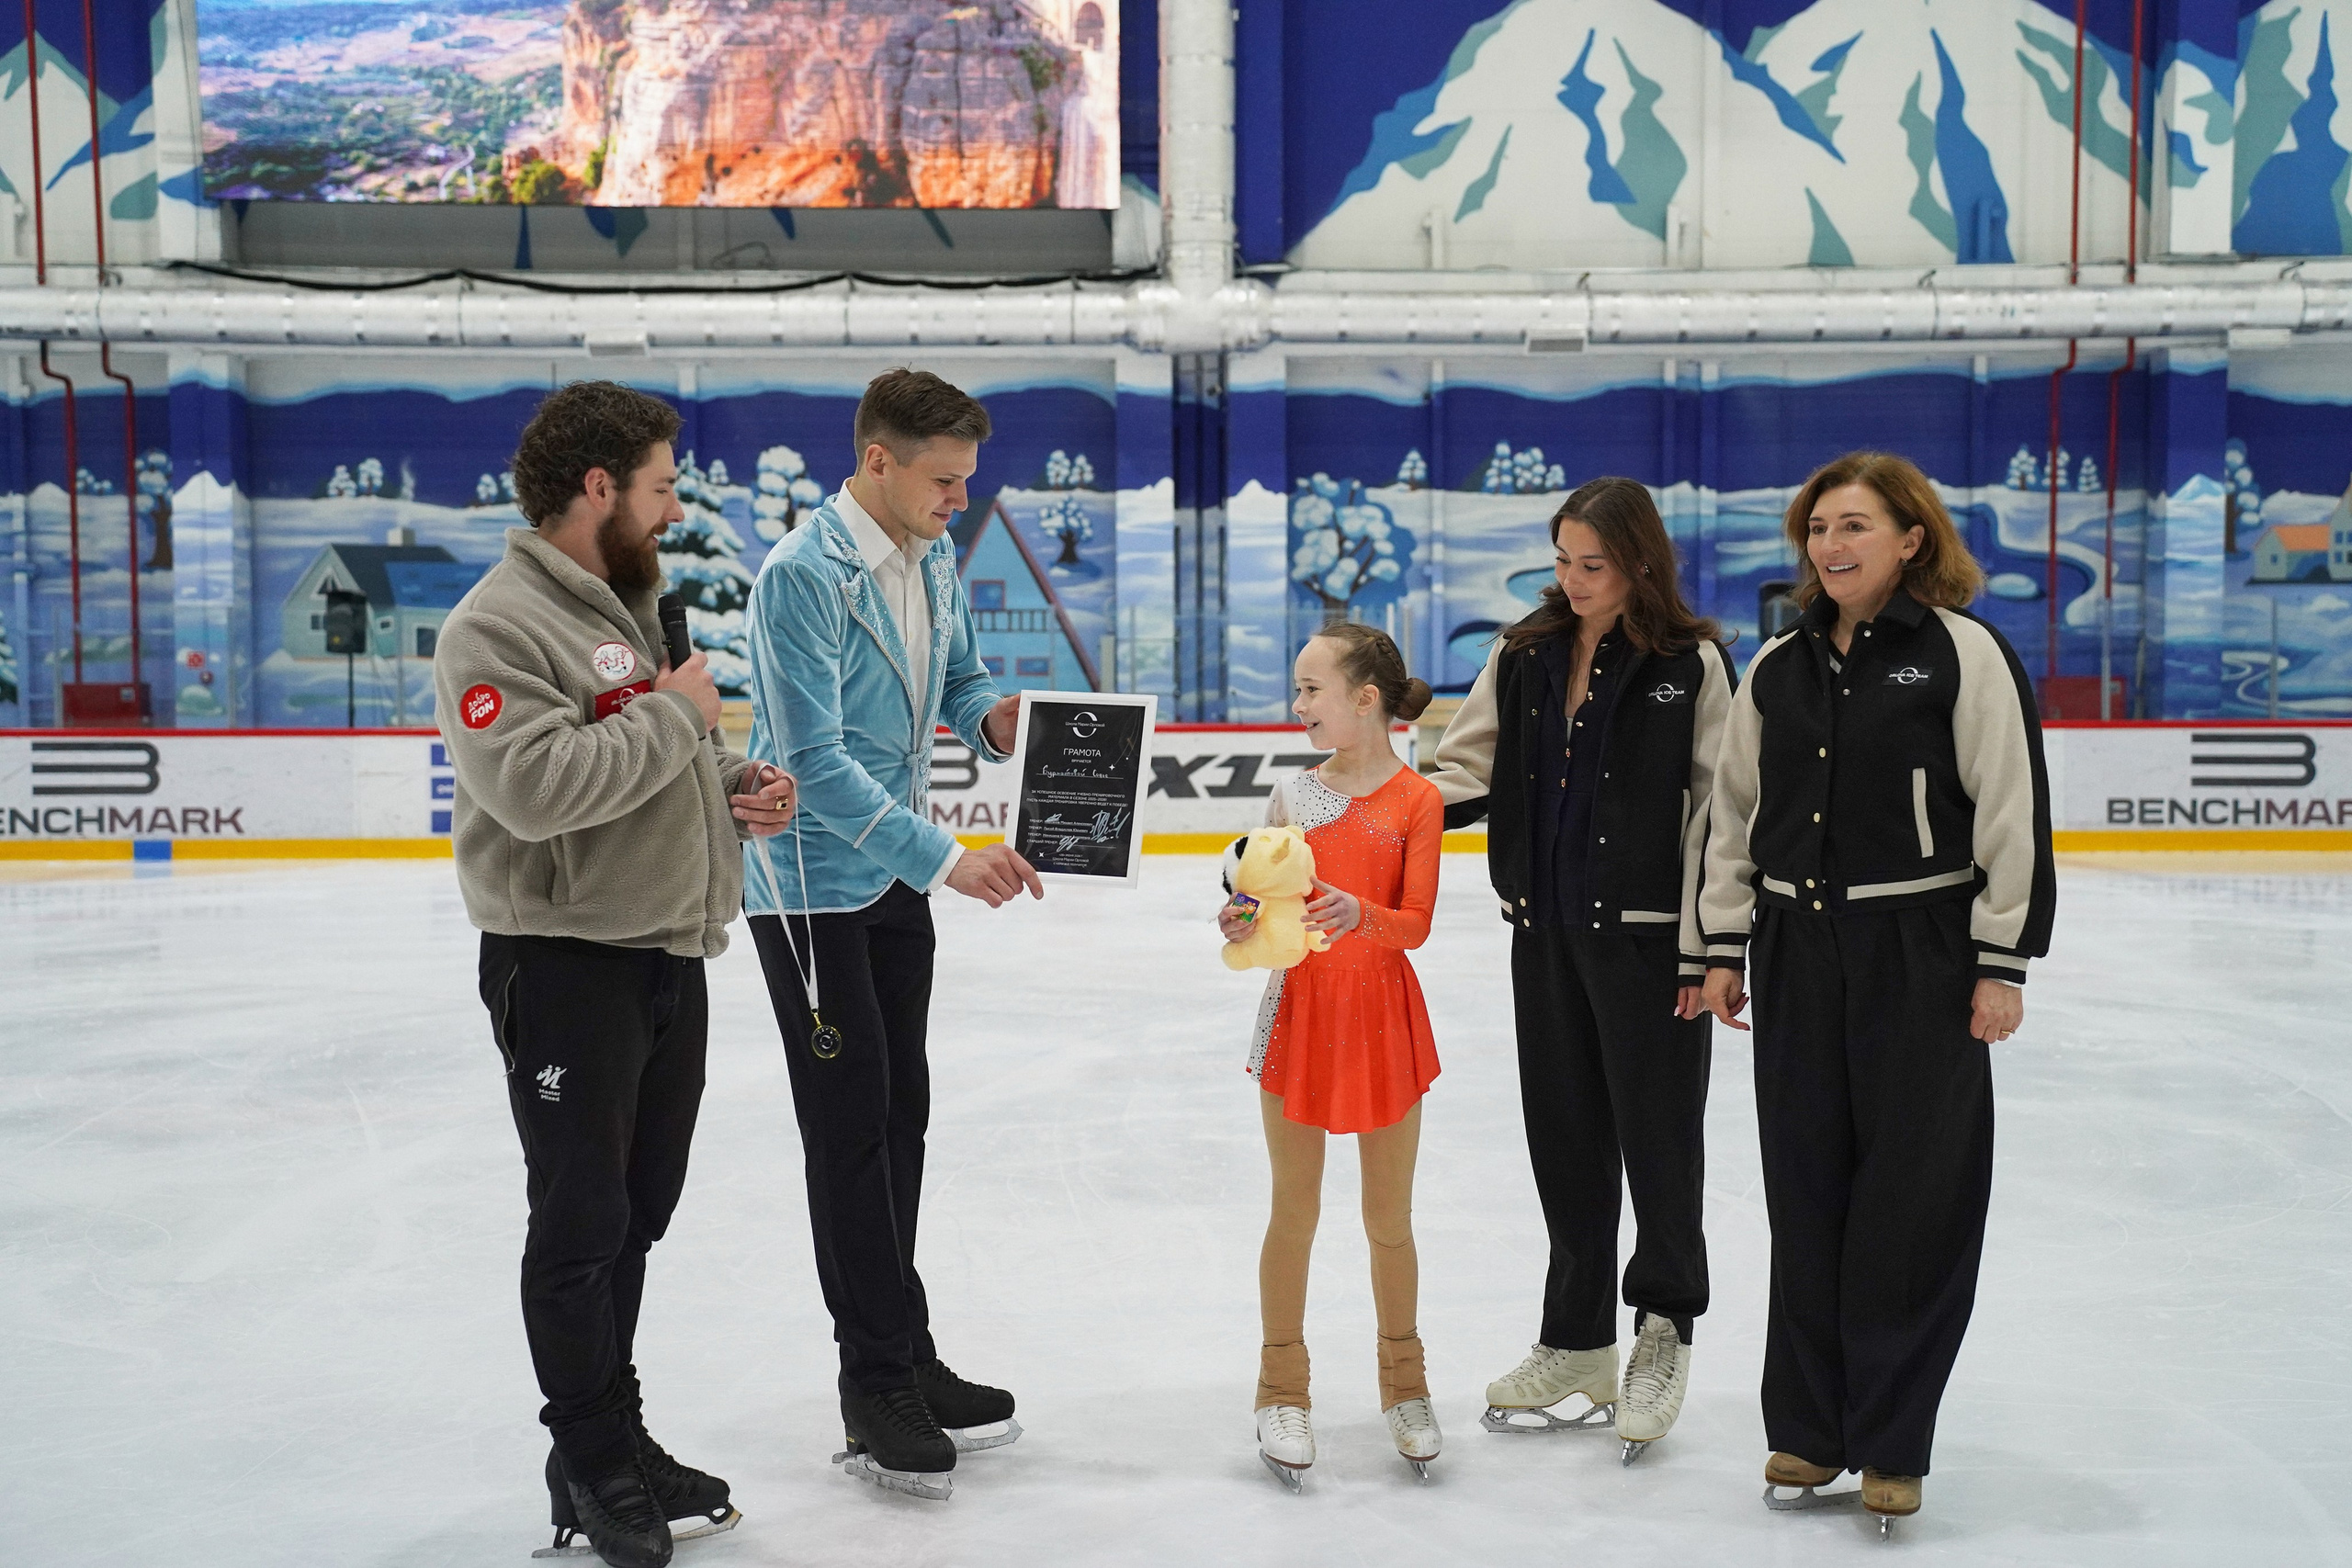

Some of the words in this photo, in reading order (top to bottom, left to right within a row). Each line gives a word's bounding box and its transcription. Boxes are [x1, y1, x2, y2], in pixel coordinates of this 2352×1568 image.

[471, 699, 494, 723] FON
[1063, 748, 1102, 757] ГРАМОТА
[0, 807, 244, 834] NCHMARK
[2107, 798, 2352, 825] BENCHMAR
